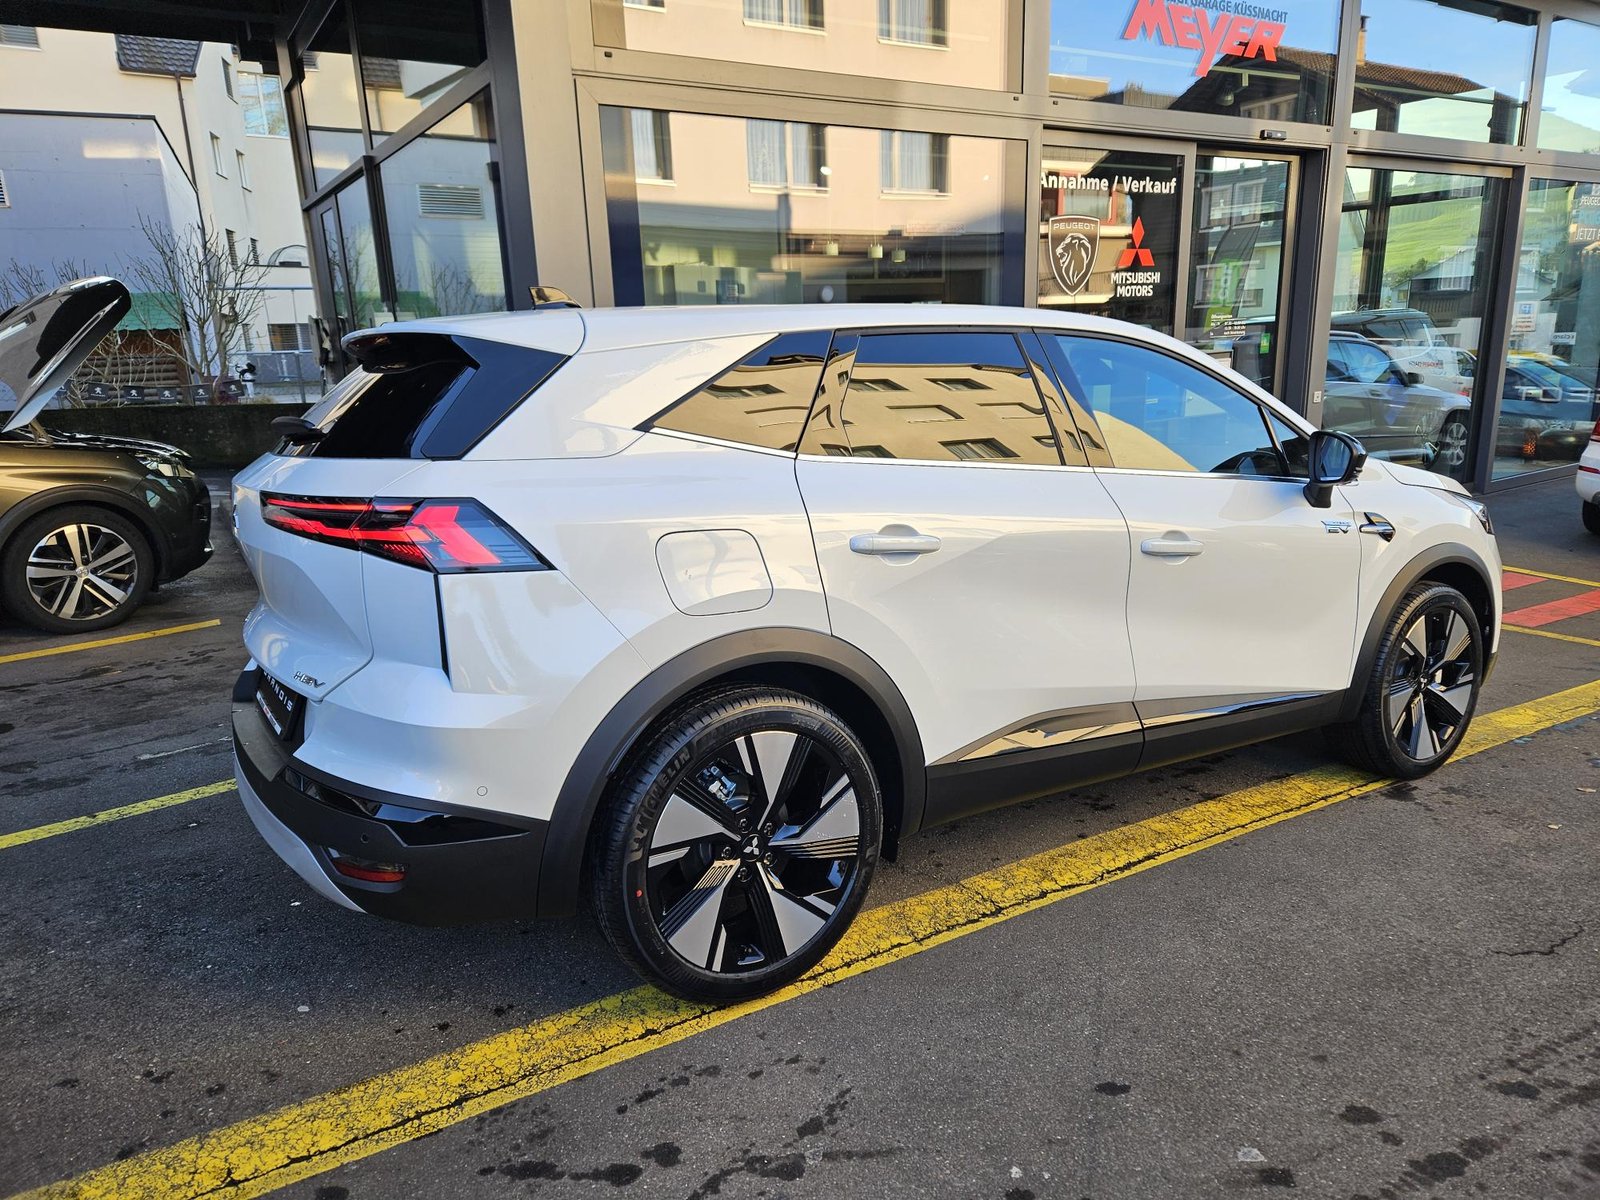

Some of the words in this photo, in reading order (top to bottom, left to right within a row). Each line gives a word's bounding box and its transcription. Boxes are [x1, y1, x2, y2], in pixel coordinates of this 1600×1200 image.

[1233, 1, 1288, 23] KÜSSNACHT
[1121, 0, 1286, 77] MEYER
[1122, 175, 1177, 194] Verkauf
[1053, 221, 1096, 231] PEUGEOT
[1111, 271, 1161, 284] MITSUBISHI
[1116, 285, 1154, 297] MOTORS
